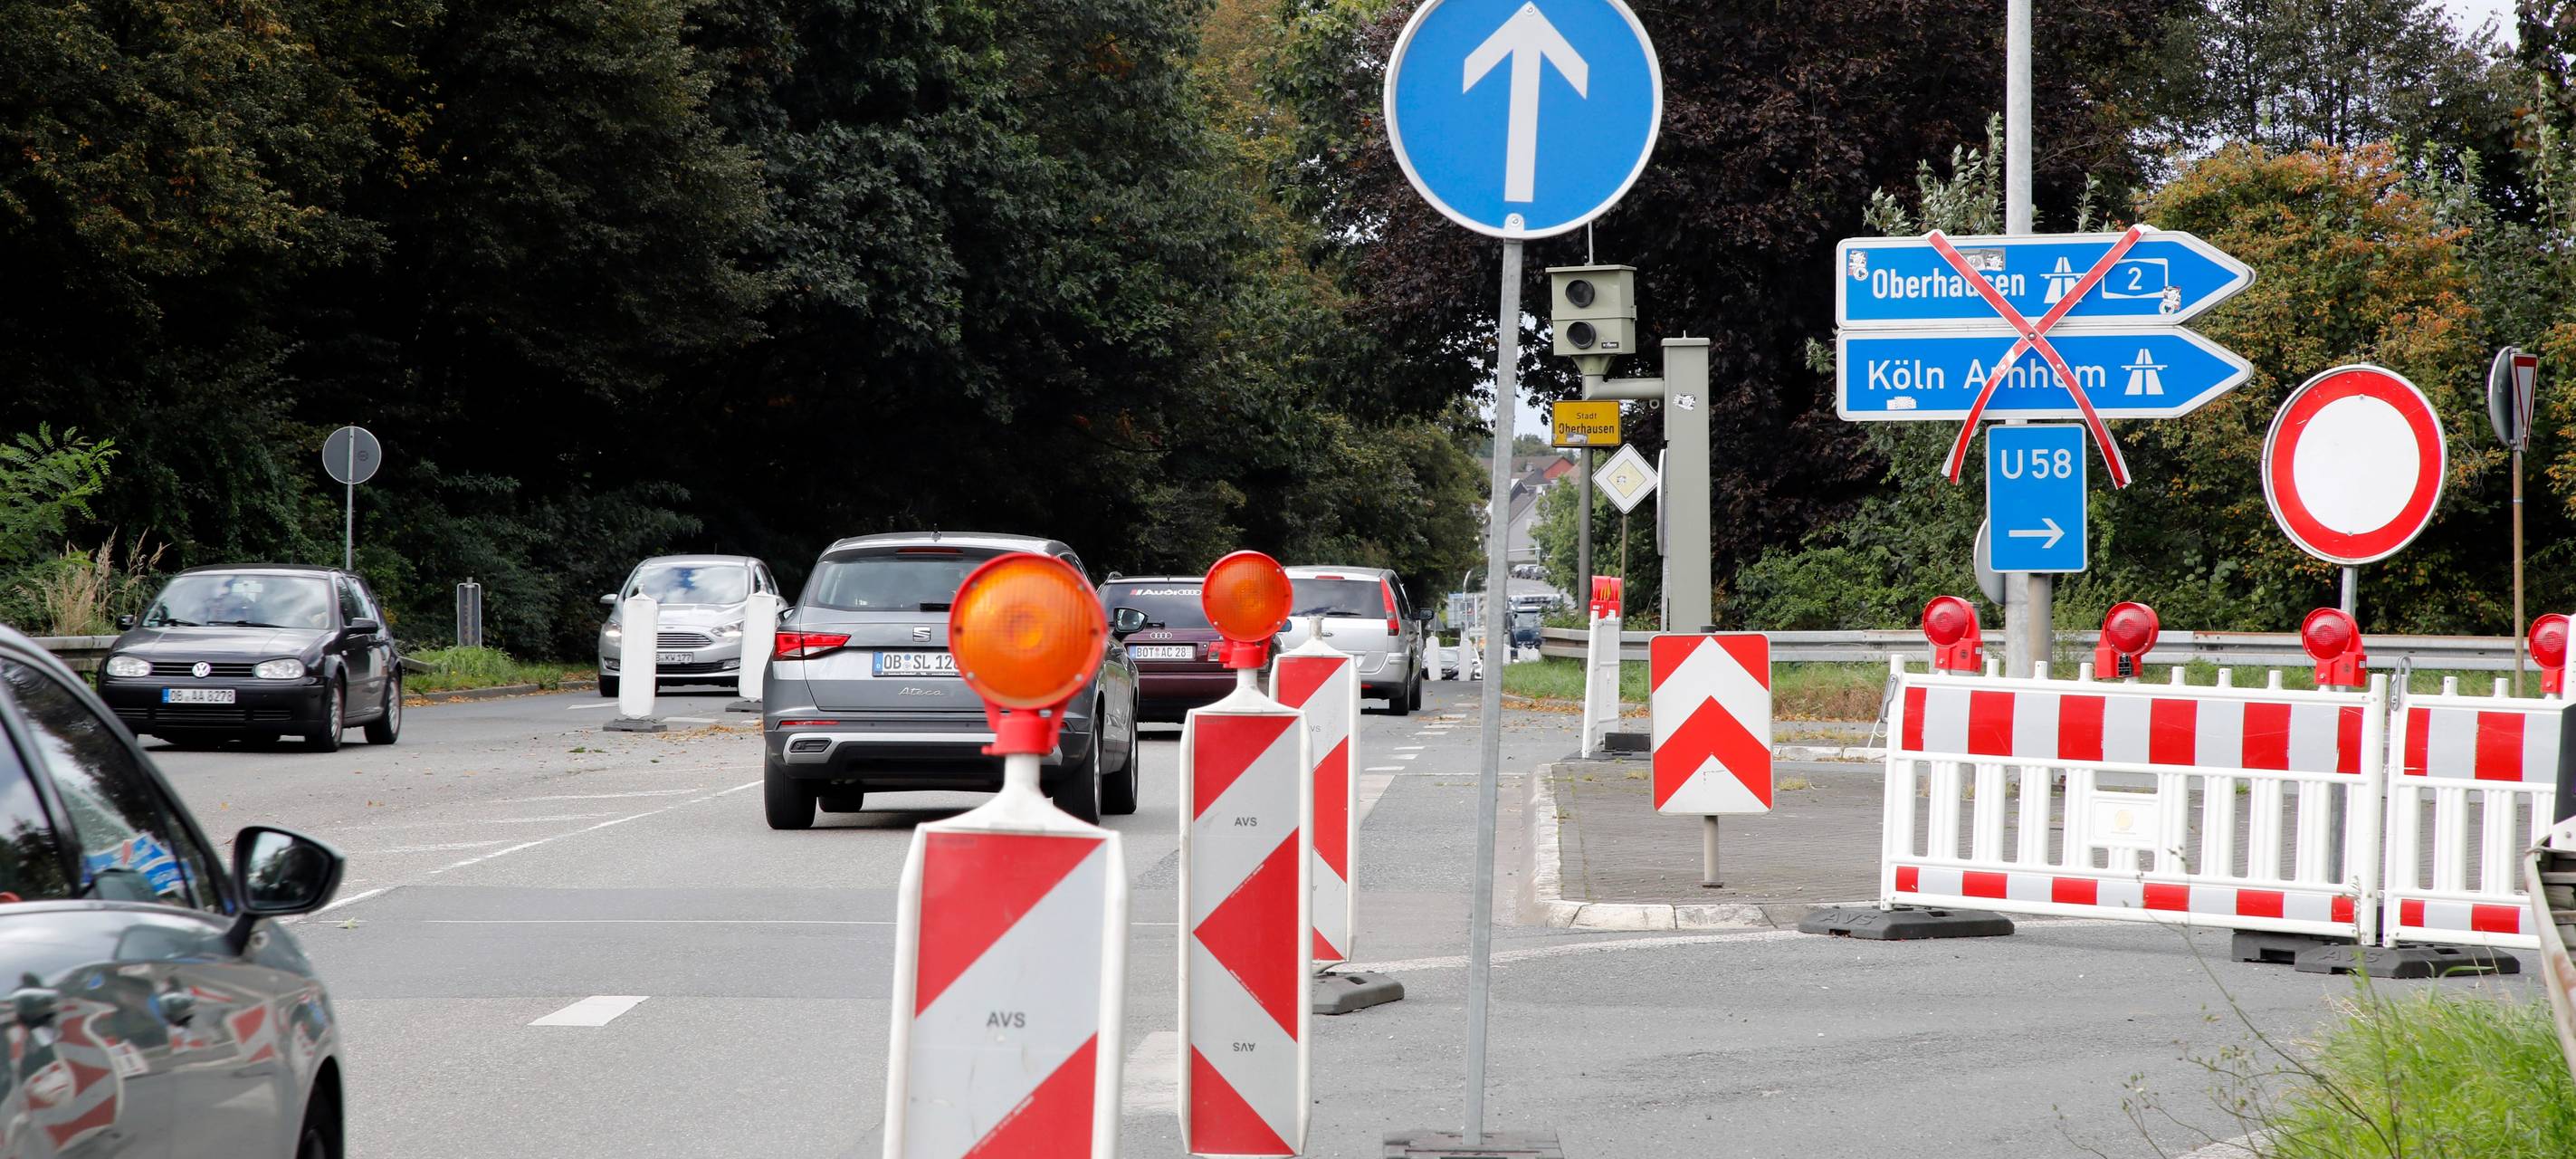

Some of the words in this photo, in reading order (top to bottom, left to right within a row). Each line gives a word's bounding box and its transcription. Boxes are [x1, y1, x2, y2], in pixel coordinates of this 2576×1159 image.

[1872, 267, 2025, 300] Oberhauen
[2128, 267, 2142, 290] 2
[1868, 359, 1945, 389] Köln
[1962, 358, 2106, 389] Anhm
[1559, 422, 1615, 435] Oberhausen
[1137, 647, 1154, 657] BOT
[1161, 647, 1173, 657] AC
[1175, 647, 1187, 657] 28
[883, 654, 902, 670] OB
[913, 654, 930, 670] SL
[935, 654, 958, 670] 12
[171, 690, 182, 702] OB
[192, 690, 204, 702] AA
[207, 690, 233, 702] 8278
[898, 687, 942, 696] Ateca
[1234, 817, 1258, 827] AVS
[1818, 910, 1879, 925] AVS
[986, 1011, 1026, 1029] AVS
[1232, 1042, 1256, 1052] AVS
